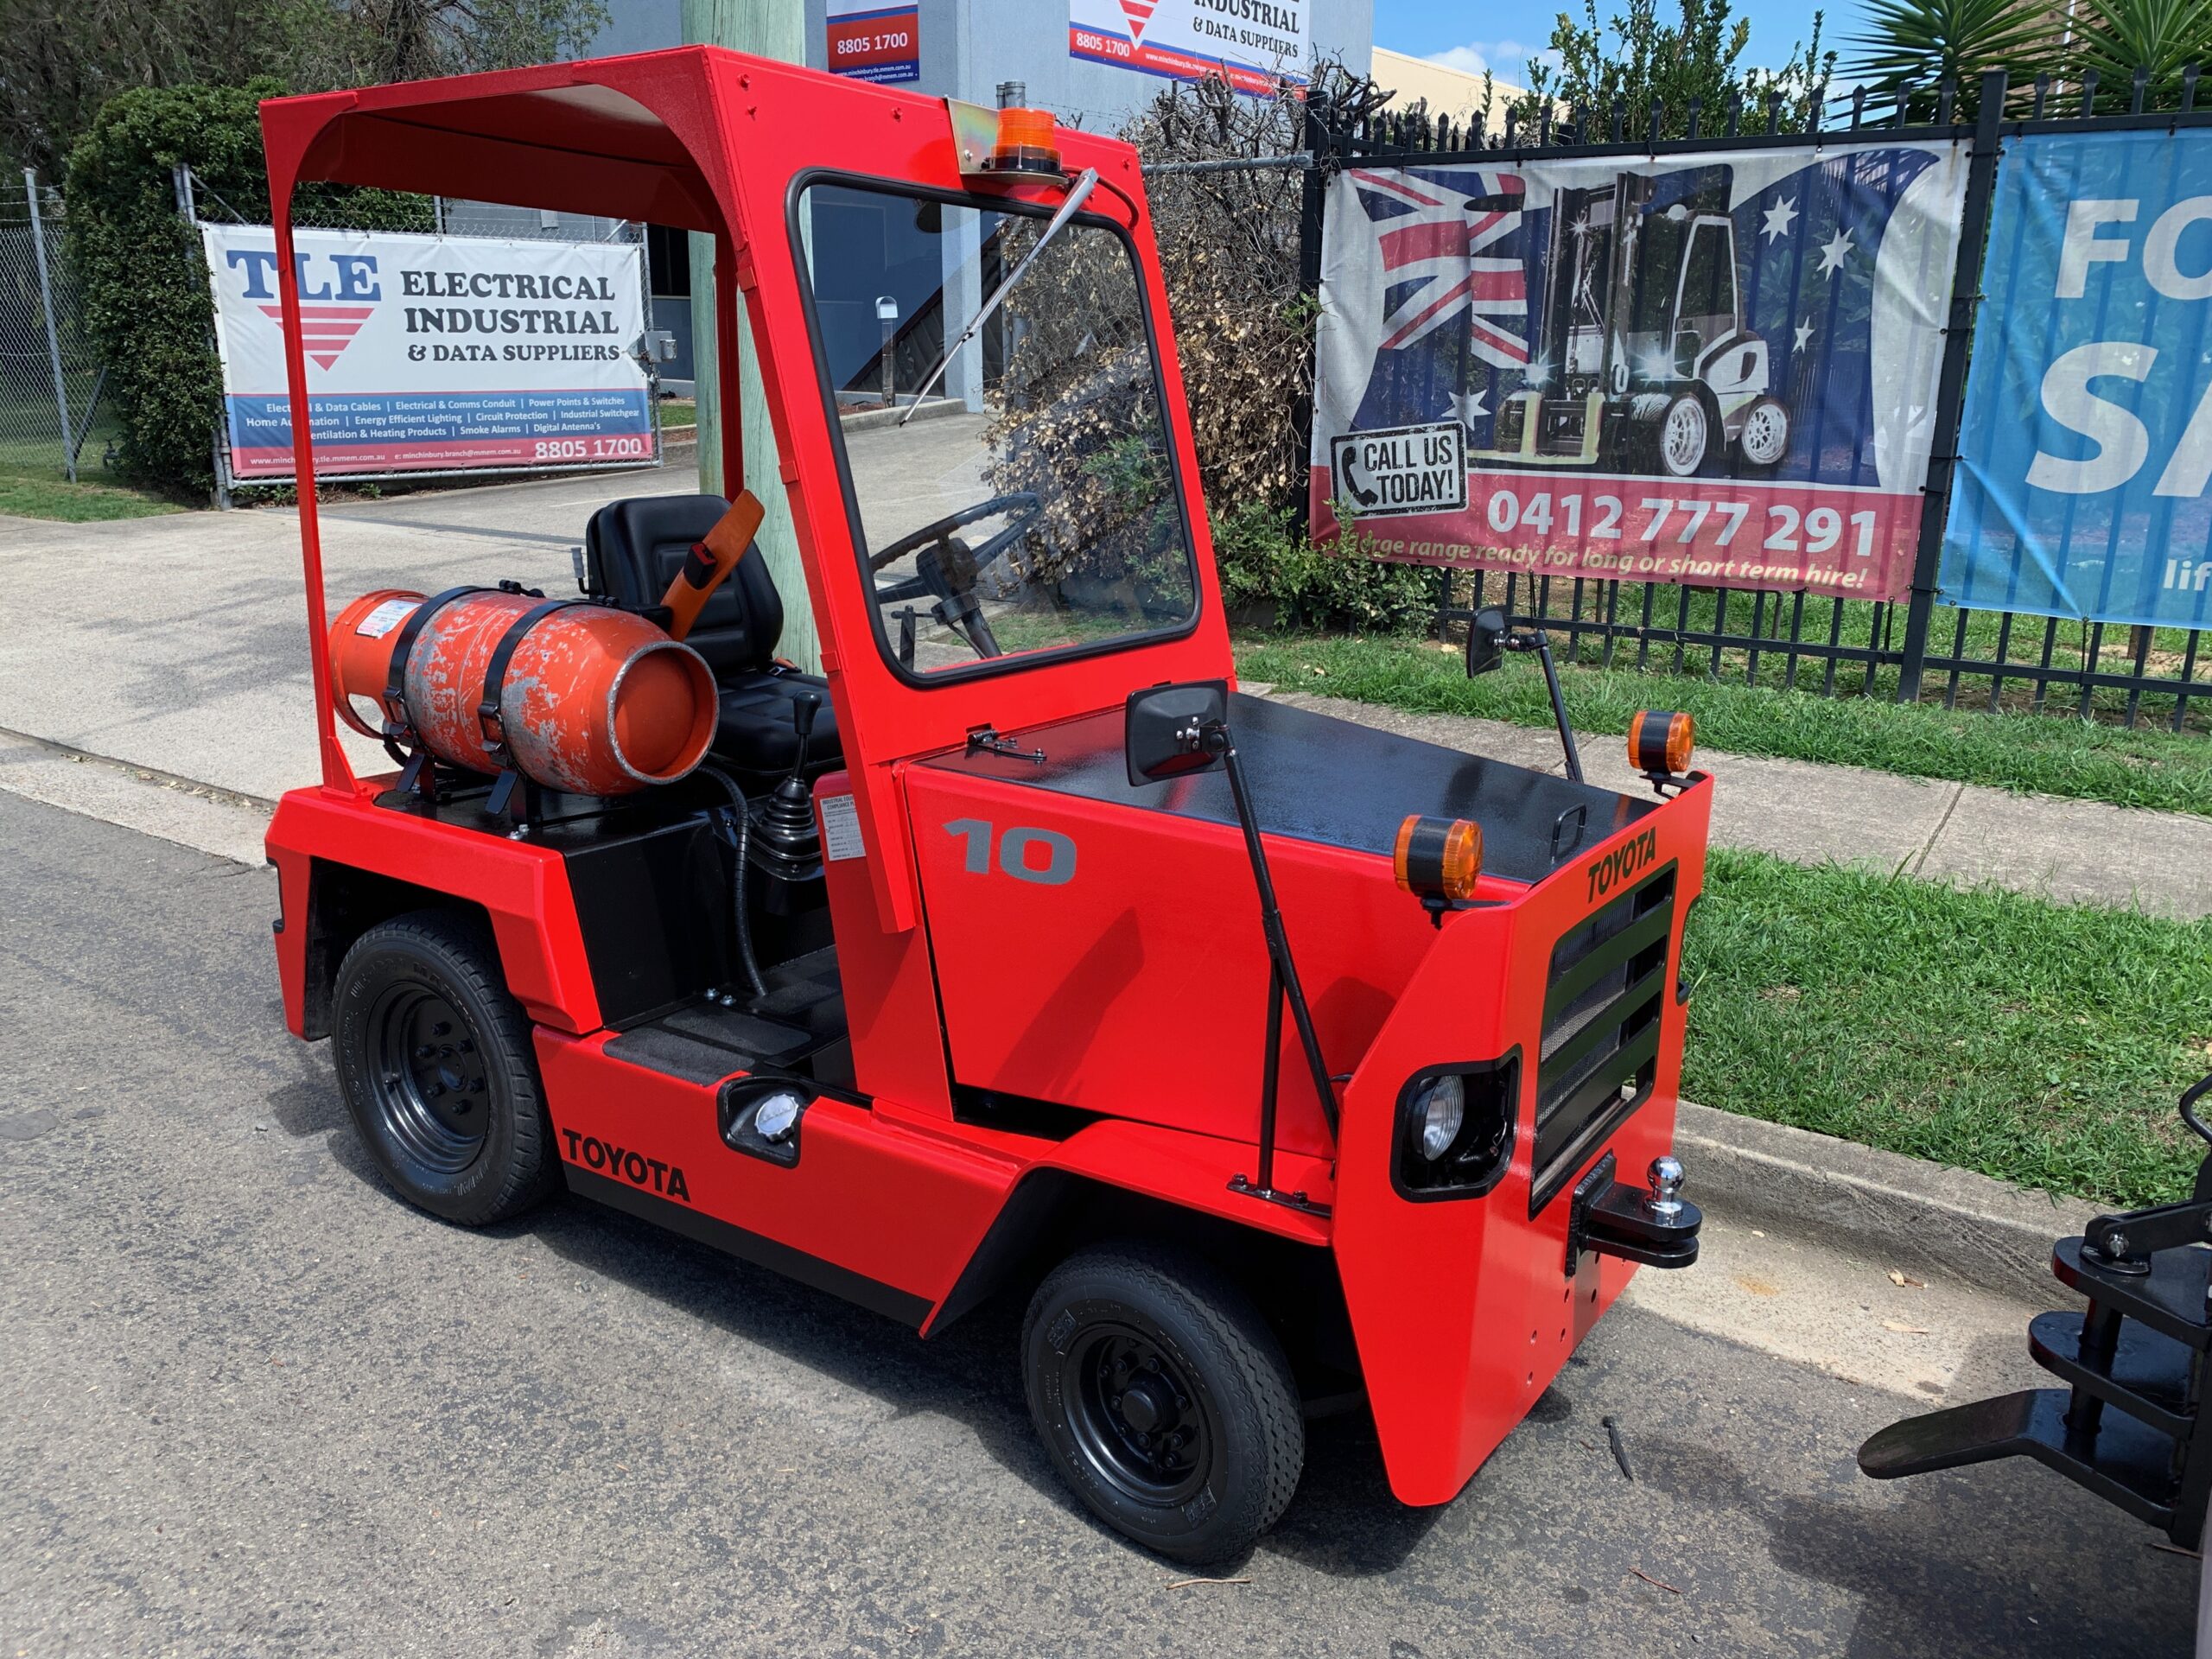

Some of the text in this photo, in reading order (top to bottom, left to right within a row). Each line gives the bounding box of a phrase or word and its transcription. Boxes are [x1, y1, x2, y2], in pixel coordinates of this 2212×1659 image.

[1194, 0, 1300, 34] DUSTRIAL
[836, 32, 908, 54] 8805 1700
[1076, 32, 1130, 57] 8805 1700
[1193, 16, 1299, 58] & DATA SUPPLIERS
[226, 250, 382, 302] TLE
[400, 270, 615, 301] ELECTRICAL
[404, 308, 620, 334] INDUSTRIAL
[408, 344, 620, 362] & DATA SUPPLIERS
[266, 402, 381, 413] Electl & Data Cables
[396, 399, 516, 410] Electrical & Comms Conduit
[529, 397, 625, 407] Power Points & Switches
[561, 409, 639, 419] Industrial Switchgear
[246, 417, 277, 427] Home
[355, 413, 462, 426] Energy Efficient Lighting
[476, 411, 548, 422] Circuit Protection
[533, 422, 601, 433] Digital Antenna's
[310, 427, 447, 440] entilation & Heating Products
[460, 424, 521, 435] Smoke Alarms
[534, 437, 642, 460] 8805 1700
[1364, 435, 1452, 472] CALL US
[1376, 469, 1453, 505] TODAY!
[1487, 490, 1877, 557] 0412 777 291
[1408, 540, 1471, 562] range
[1475, 543, 1540, 569] ready
[1544, 545, 1578, 574] for
[1581, 547, 1635, 575] long
[1639, 556, 1667, 574] or
[1668, 555, 1735, 579] short
[1739, 563, 1800, 583] term
[1803, 566, 1869, 589] hire!
[942, 817, 1077, 885] 10
[1587, 826, 1656, 904] TOYOTA
[563, 1128, 690, 1203] TOYOTA
